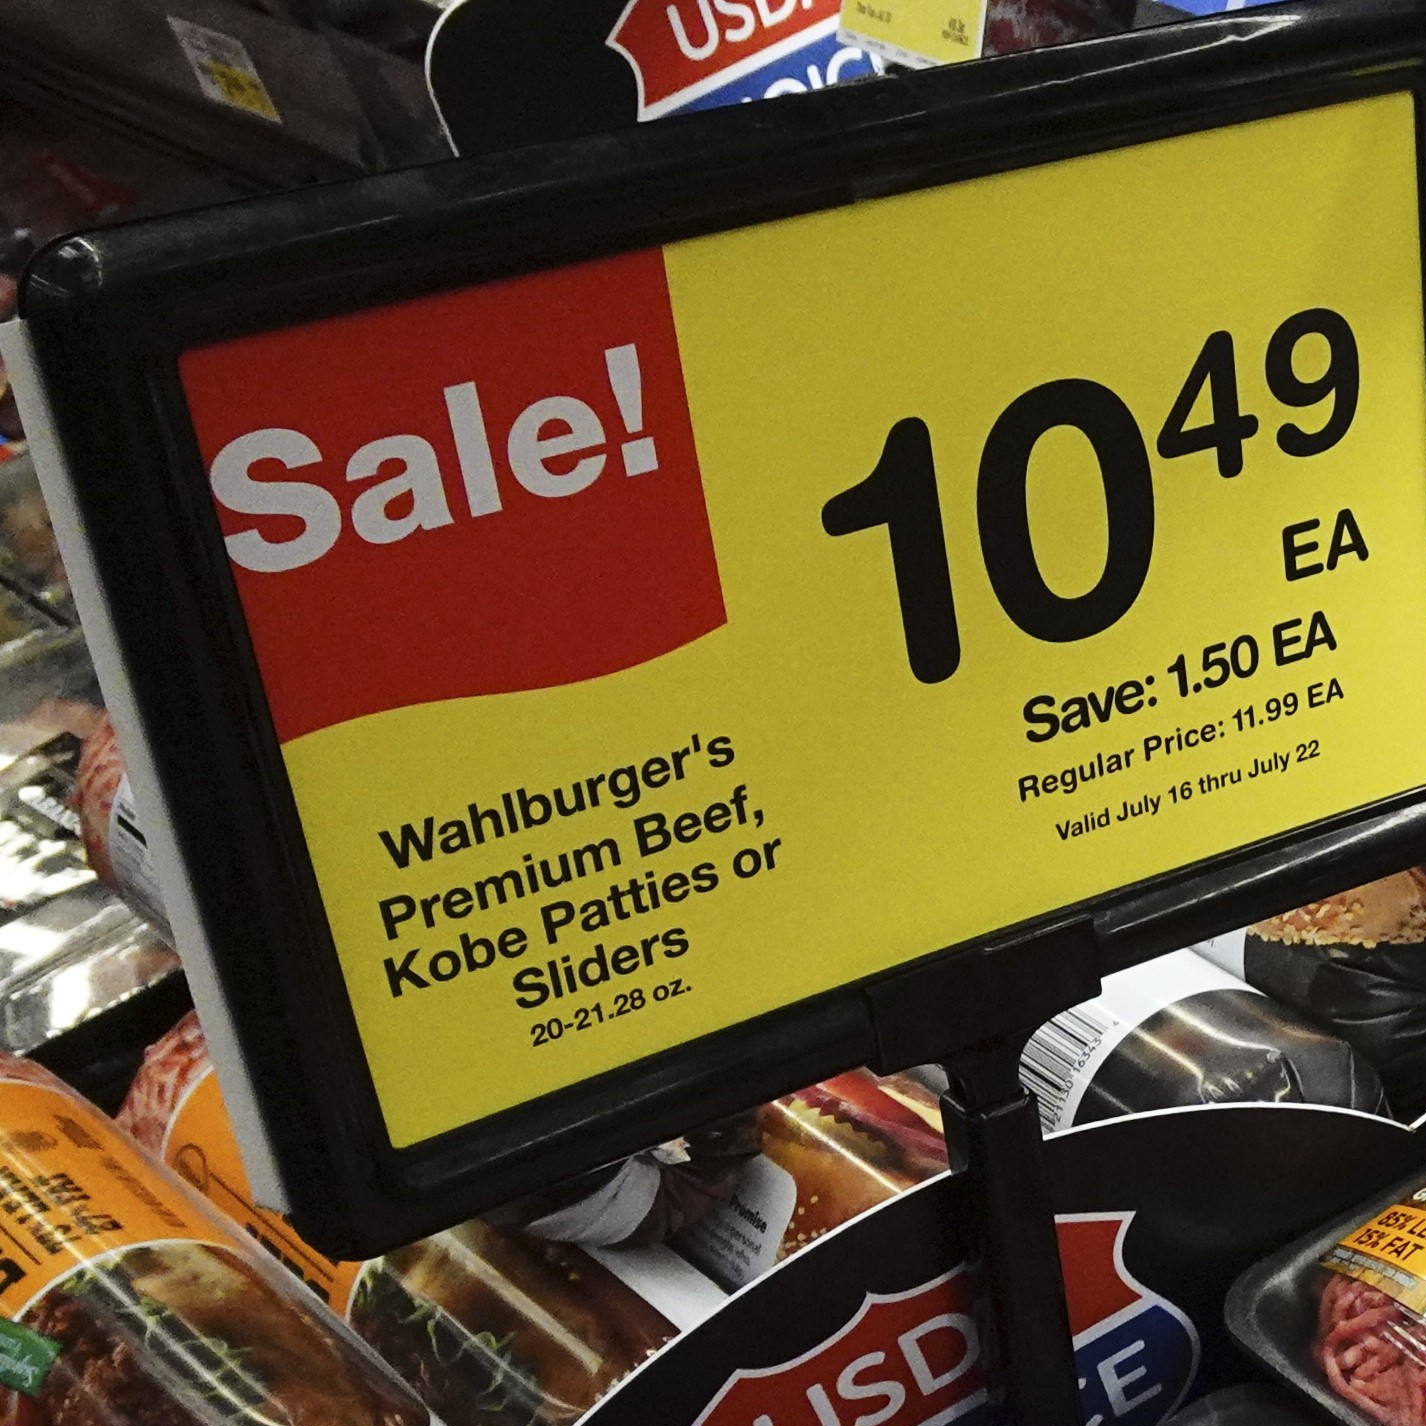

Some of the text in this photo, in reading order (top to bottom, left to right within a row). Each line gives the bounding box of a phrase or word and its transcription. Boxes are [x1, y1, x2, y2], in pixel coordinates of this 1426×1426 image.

[666, 0, 814, 61] USD
[210, 343, 658, 574] Sale!
[1283, 509, 1369, 582] EA
[1023, 610, 1337, 743] Save: 1.50 EA
[1018, 678, 1344, 801] Regular Price: 11.99 EA
[379, 734, 735, 869] Wahlburger's
[1056, 740, 1320, 840] Valid July 16 thru July 22
[379, 785, 765, 940] Premium Beef,
[383, 838, 781, 998] Kobe Patties or
[512, 927, 690, 1009] Sliders
[531, 976, 692, 1047] 20-21.28 oz.
[1353, 1228, 1425, 1261] 15% FAT
[1377, 1211, 1418, 1231] 85%
